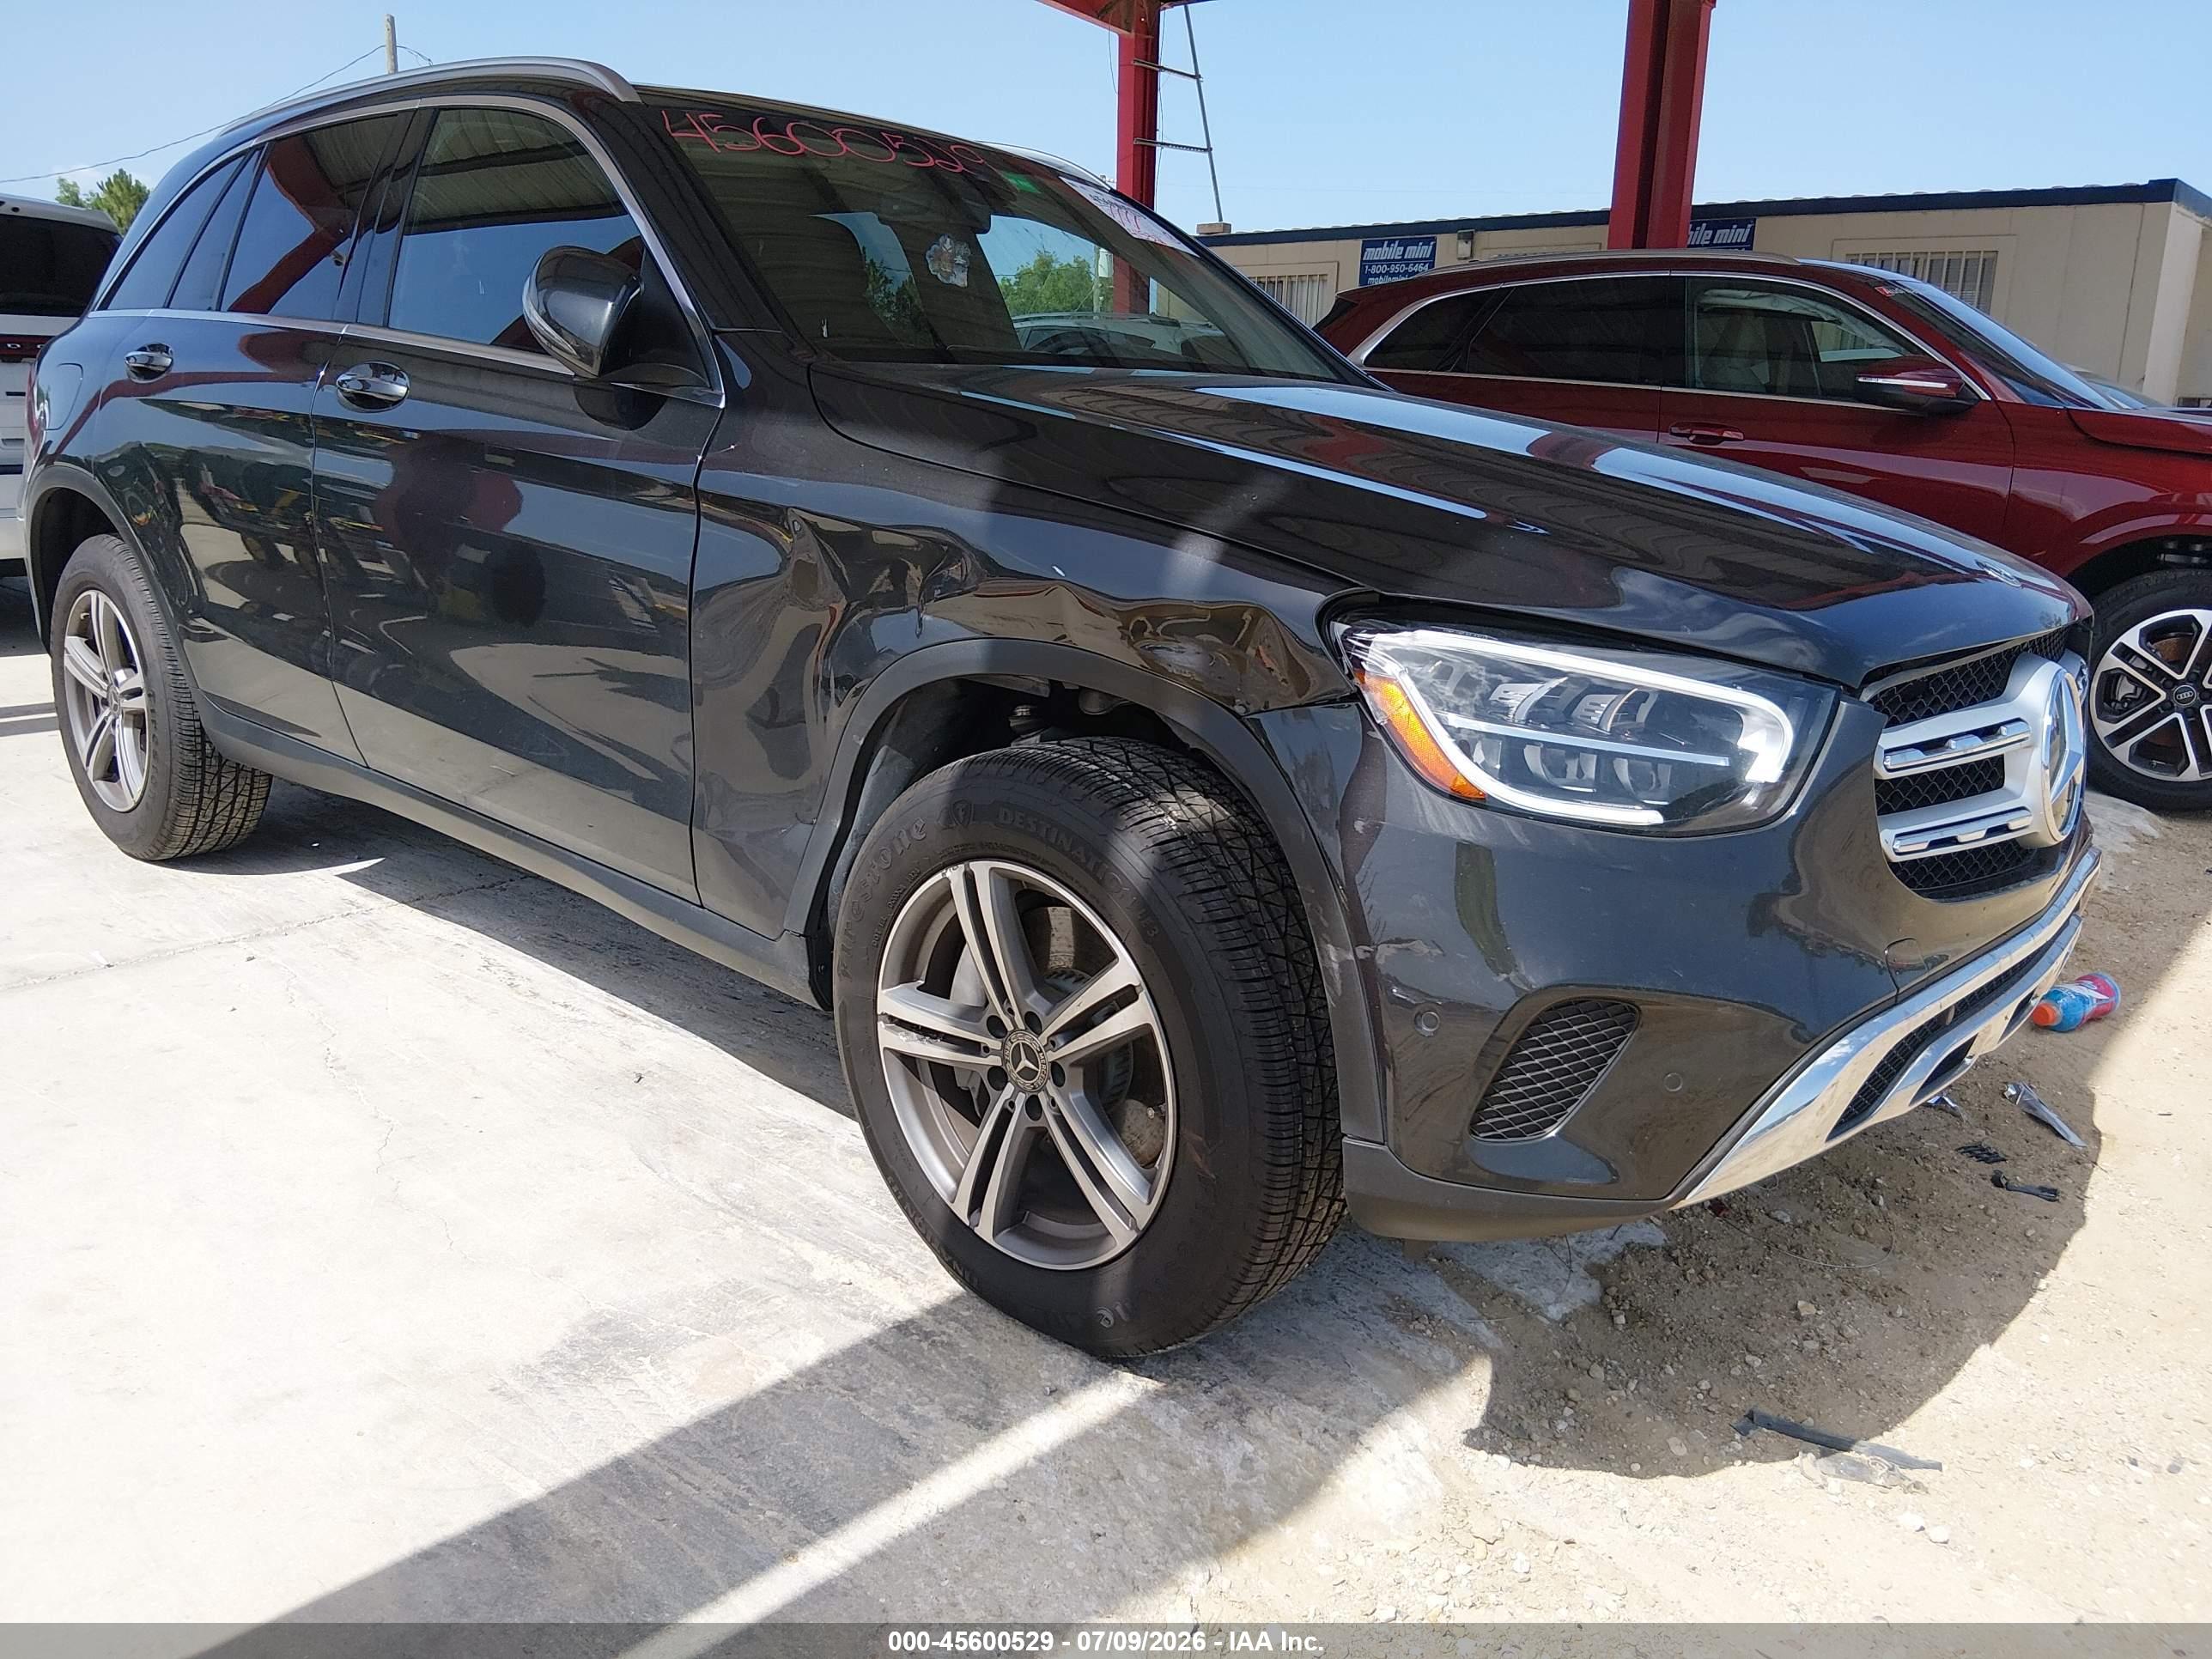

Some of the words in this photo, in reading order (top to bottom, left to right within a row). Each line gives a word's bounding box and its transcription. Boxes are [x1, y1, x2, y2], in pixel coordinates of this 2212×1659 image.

[662, 110, 1001, 176] 45600529
[1713, 224, 1753, 244] mini
[1363, 240, 1404, 260] mobile
[1404, 241, 1436, 258] mini
[1364, 263, 1430, 274] 1-800-950-6464
[837, 816, 928, 981] Firestone
[1033, 1052, 1047, 1088] MERCEDES
